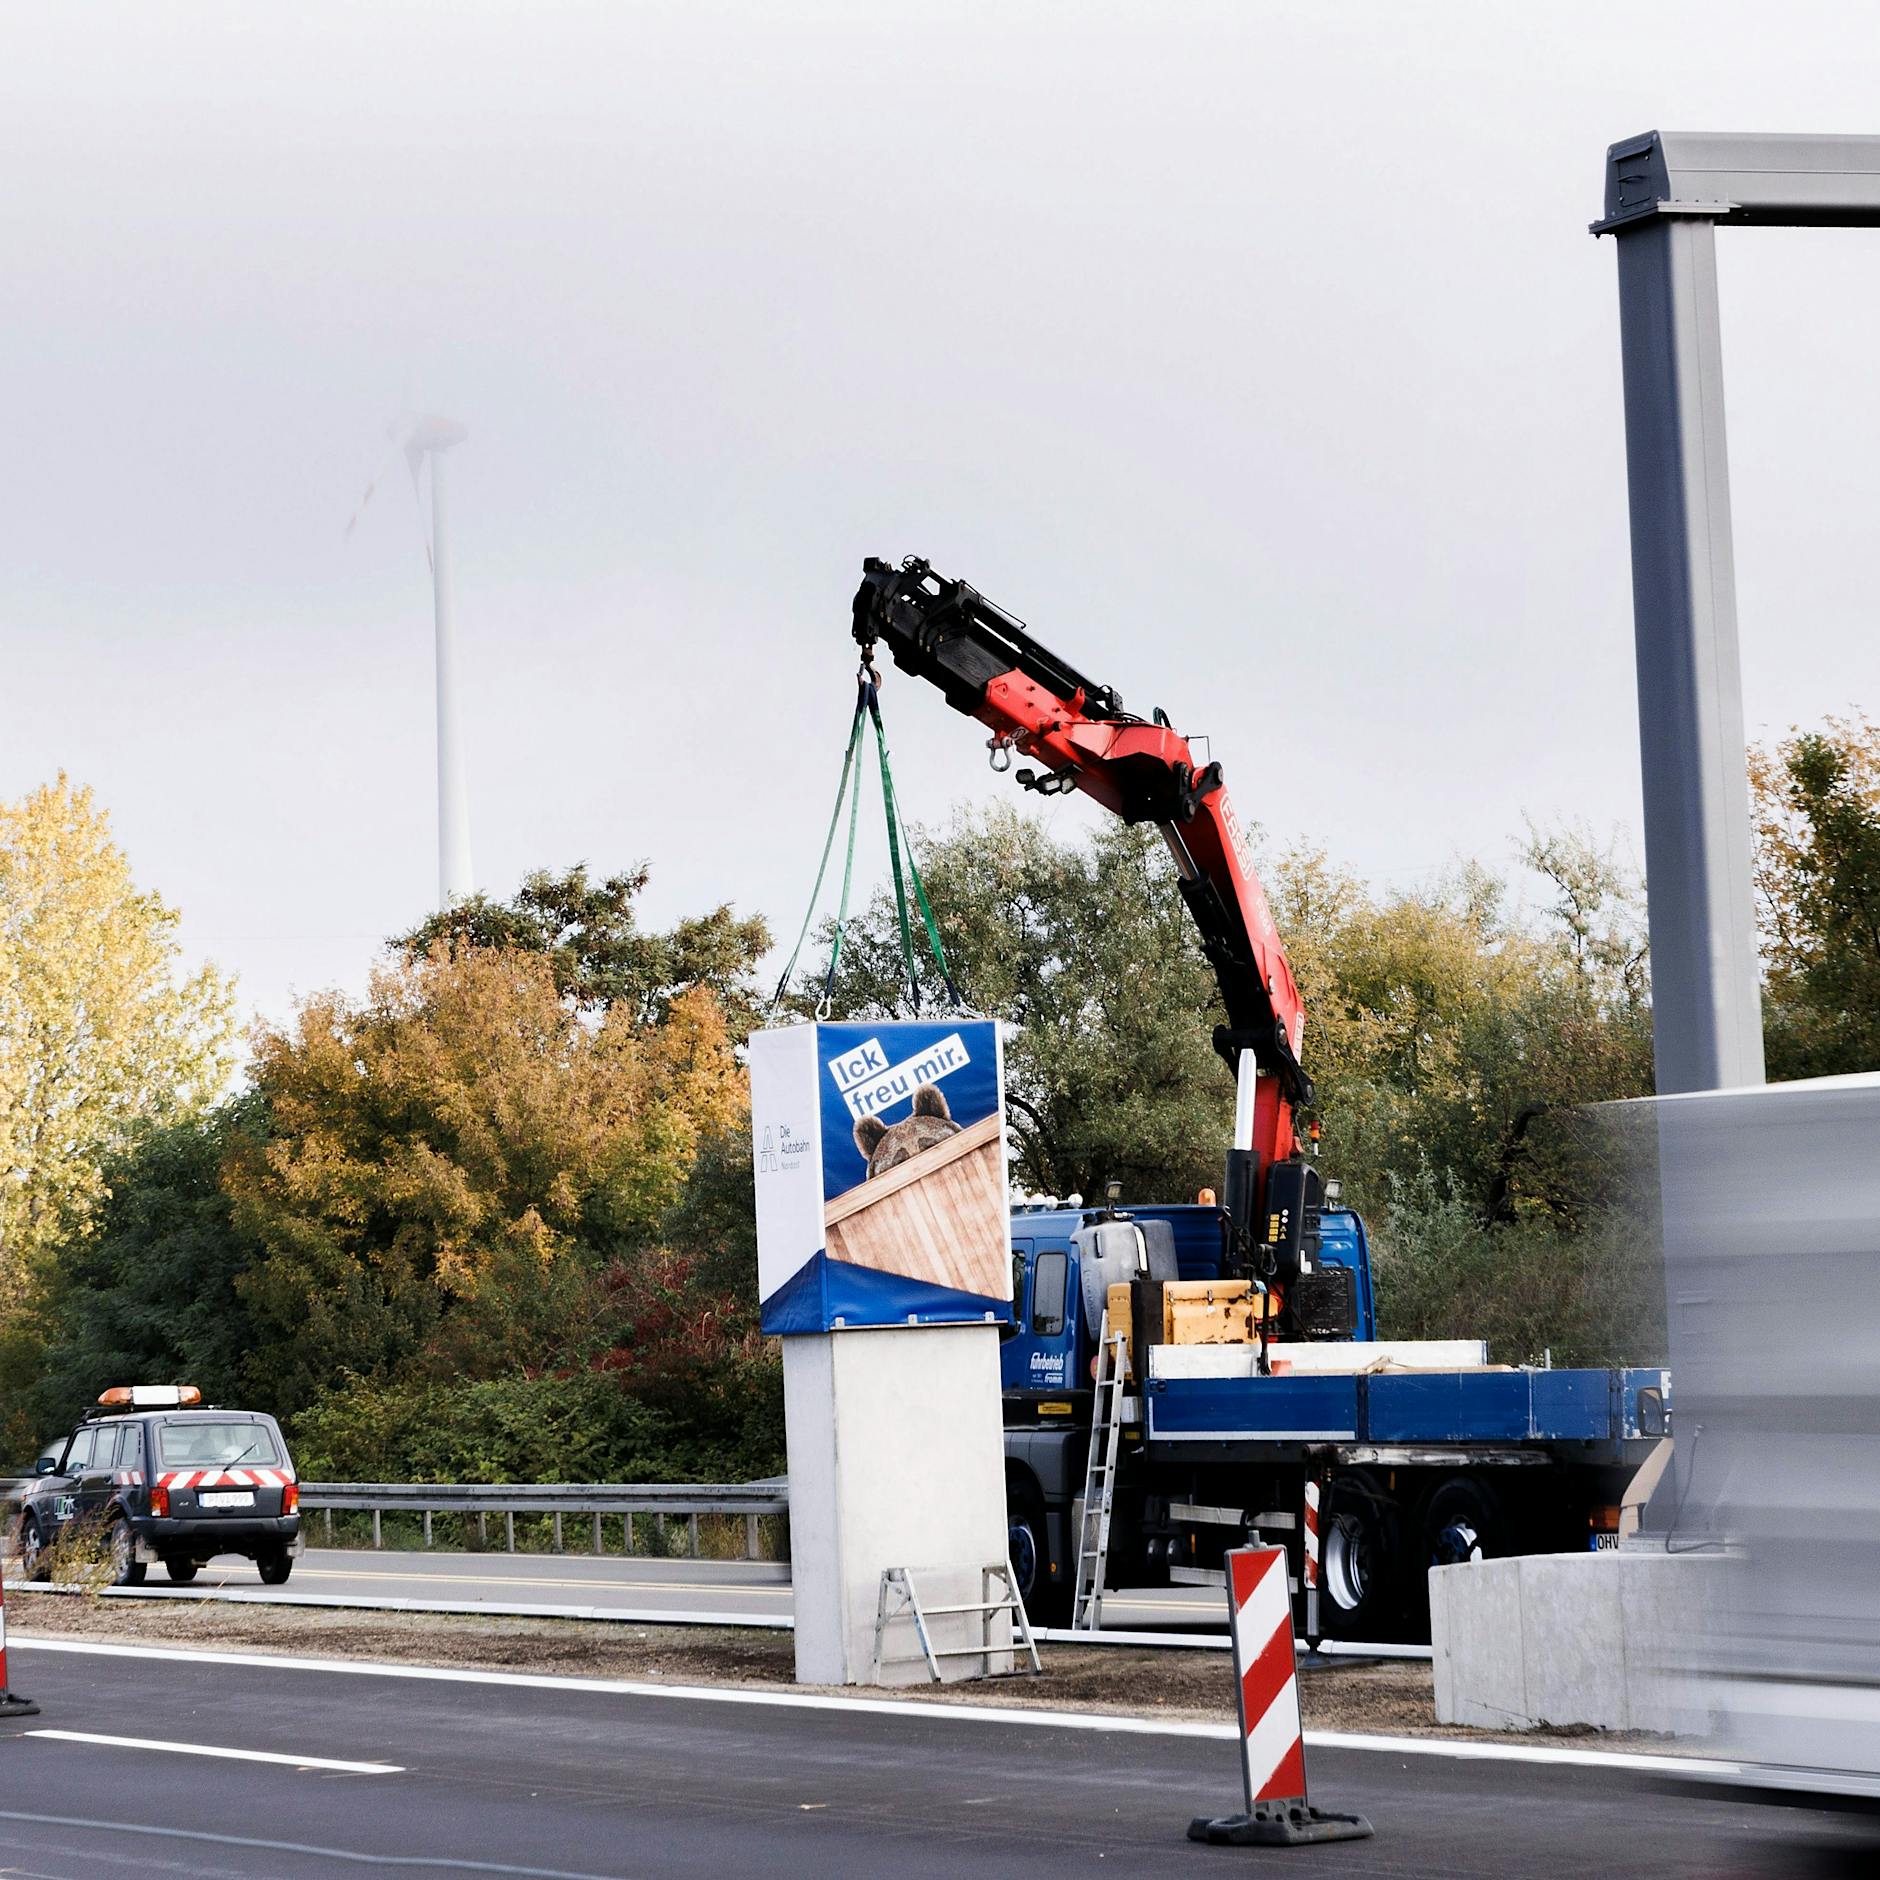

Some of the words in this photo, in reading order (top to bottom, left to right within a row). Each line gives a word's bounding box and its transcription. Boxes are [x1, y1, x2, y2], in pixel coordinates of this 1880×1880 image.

[1221, 797, 1254, 875] FASSI
[836, 1048, 882, 1084] Ick
[851, 1075, 909, 1116] freu
[912, 1047, 964, 1084] mir.
[780, 1124, 790, 1138] Die
[780, 1140, 810, 1155] Autobahn
[1597, 1535, 1619, 1550] OHV
